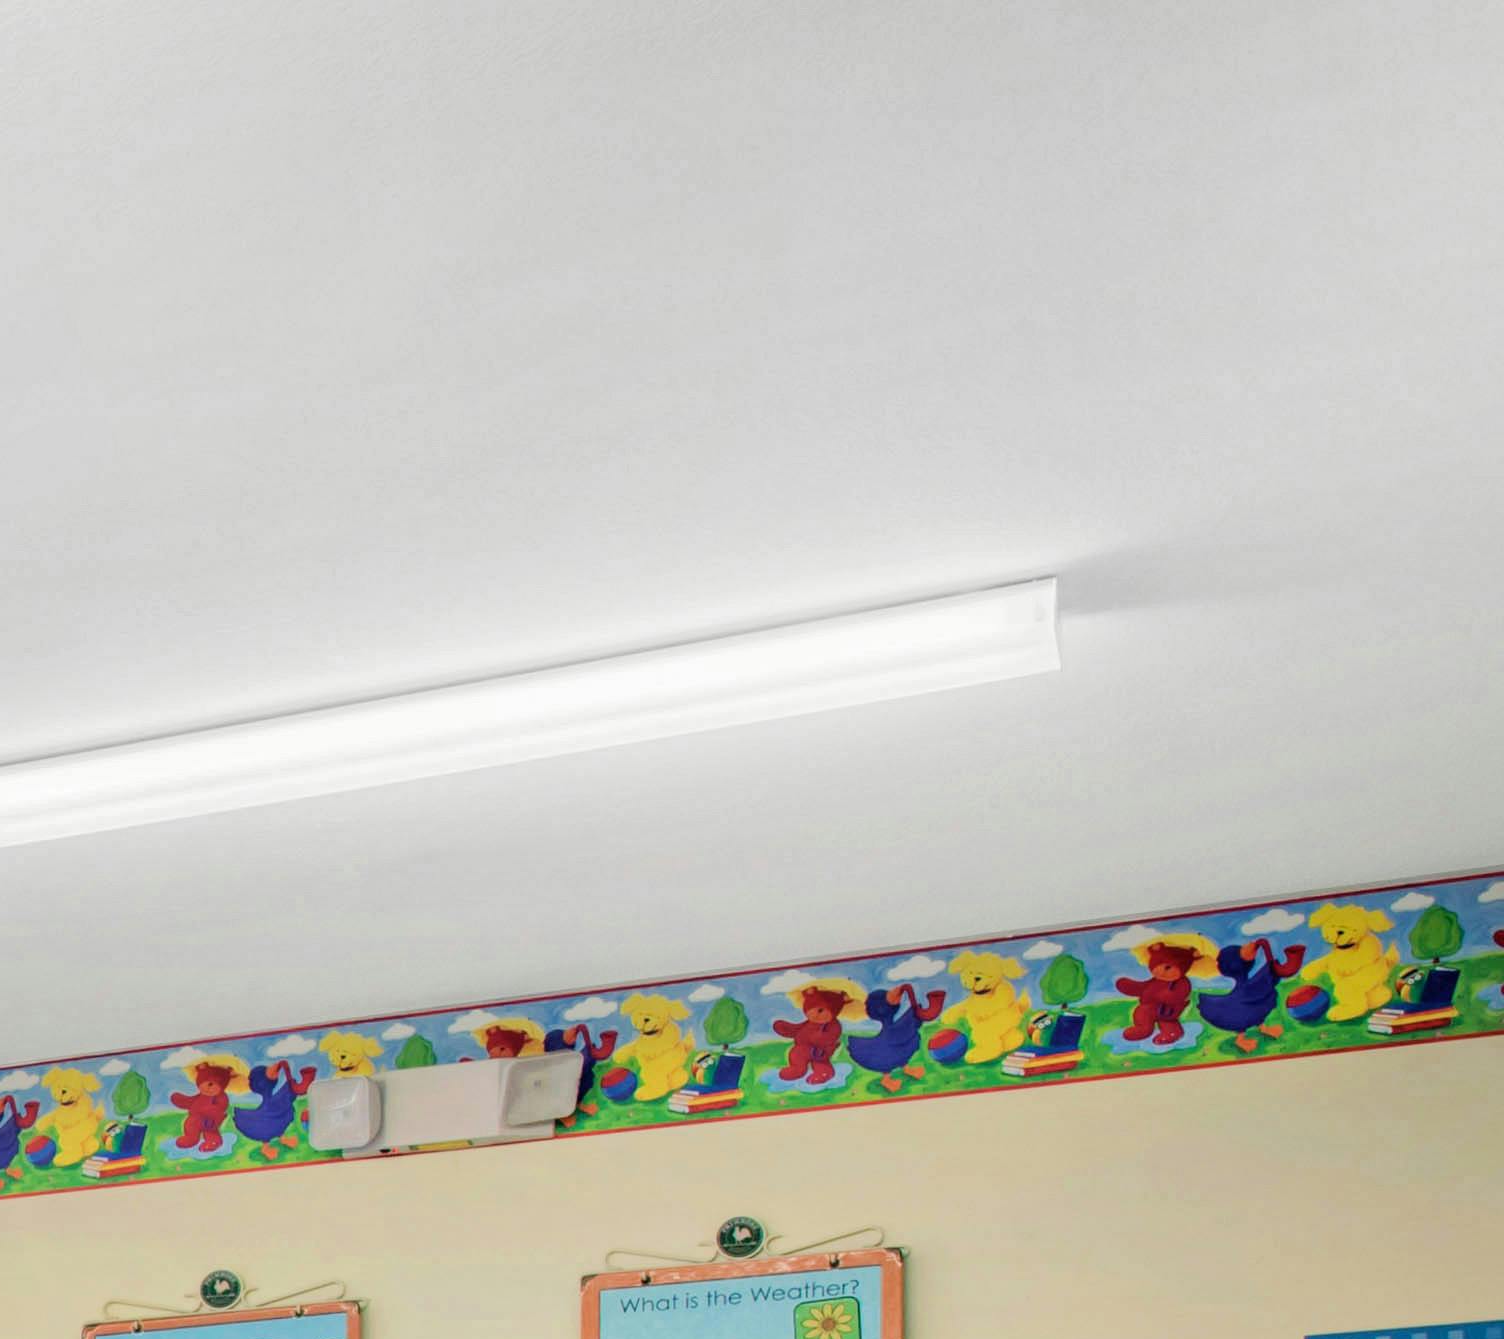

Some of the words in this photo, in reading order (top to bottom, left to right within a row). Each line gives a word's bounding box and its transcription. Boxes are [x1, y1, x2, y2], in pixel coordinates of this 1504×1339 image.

[620, 1292, 679, 1314] What
[685, 1291, 699, 1310] is
[706, 1289, 743, 1308] the
[750, 1278, 860, 1303] Weather?
